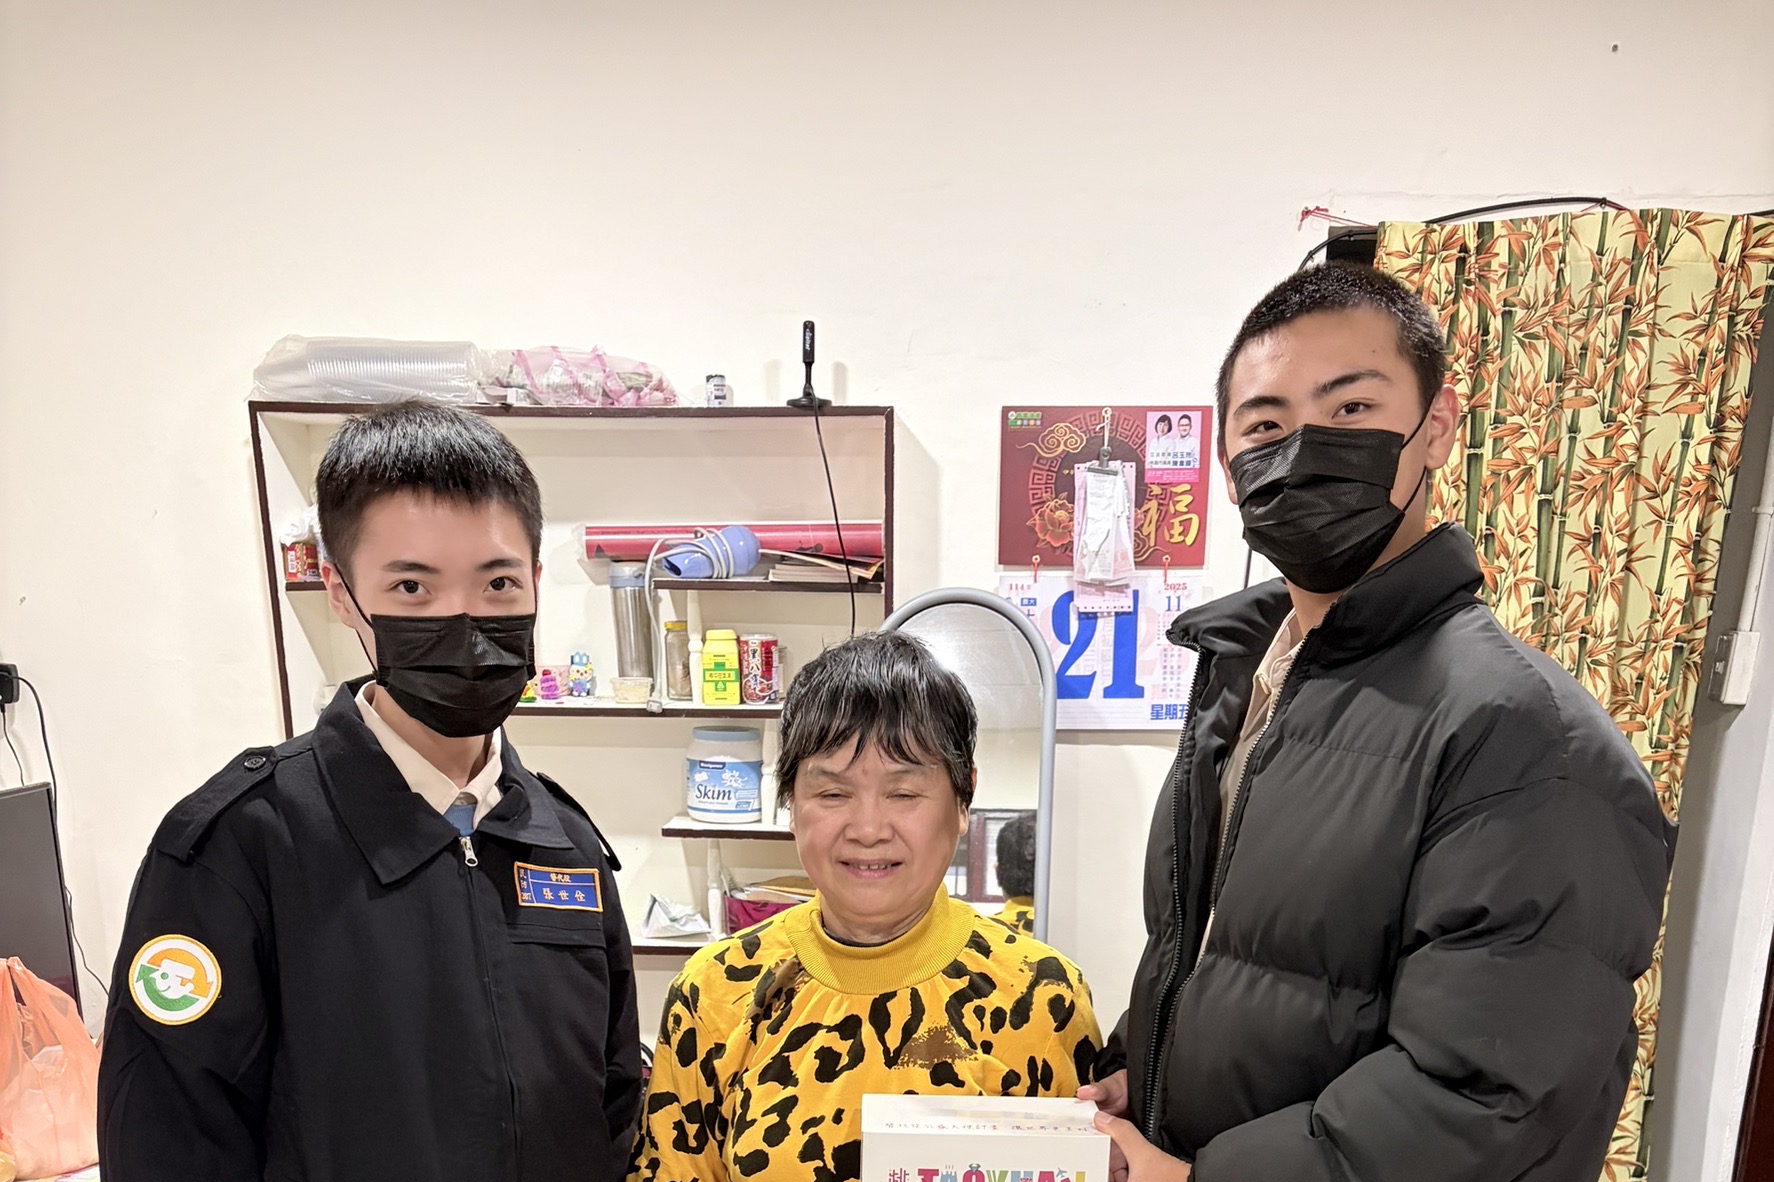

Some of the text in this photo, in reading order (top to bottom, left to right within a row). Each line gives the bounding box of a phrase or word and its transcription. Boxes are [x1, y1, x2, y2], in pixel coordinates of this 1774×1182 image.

[1141, 483, 1199, 547] 福
[1163, 583, 1188, 591] 2025
[1165, 595, 1182, 612] 11
[1051, 589, 1145, 699] 21
[695, 783, 732, 800] Skim
